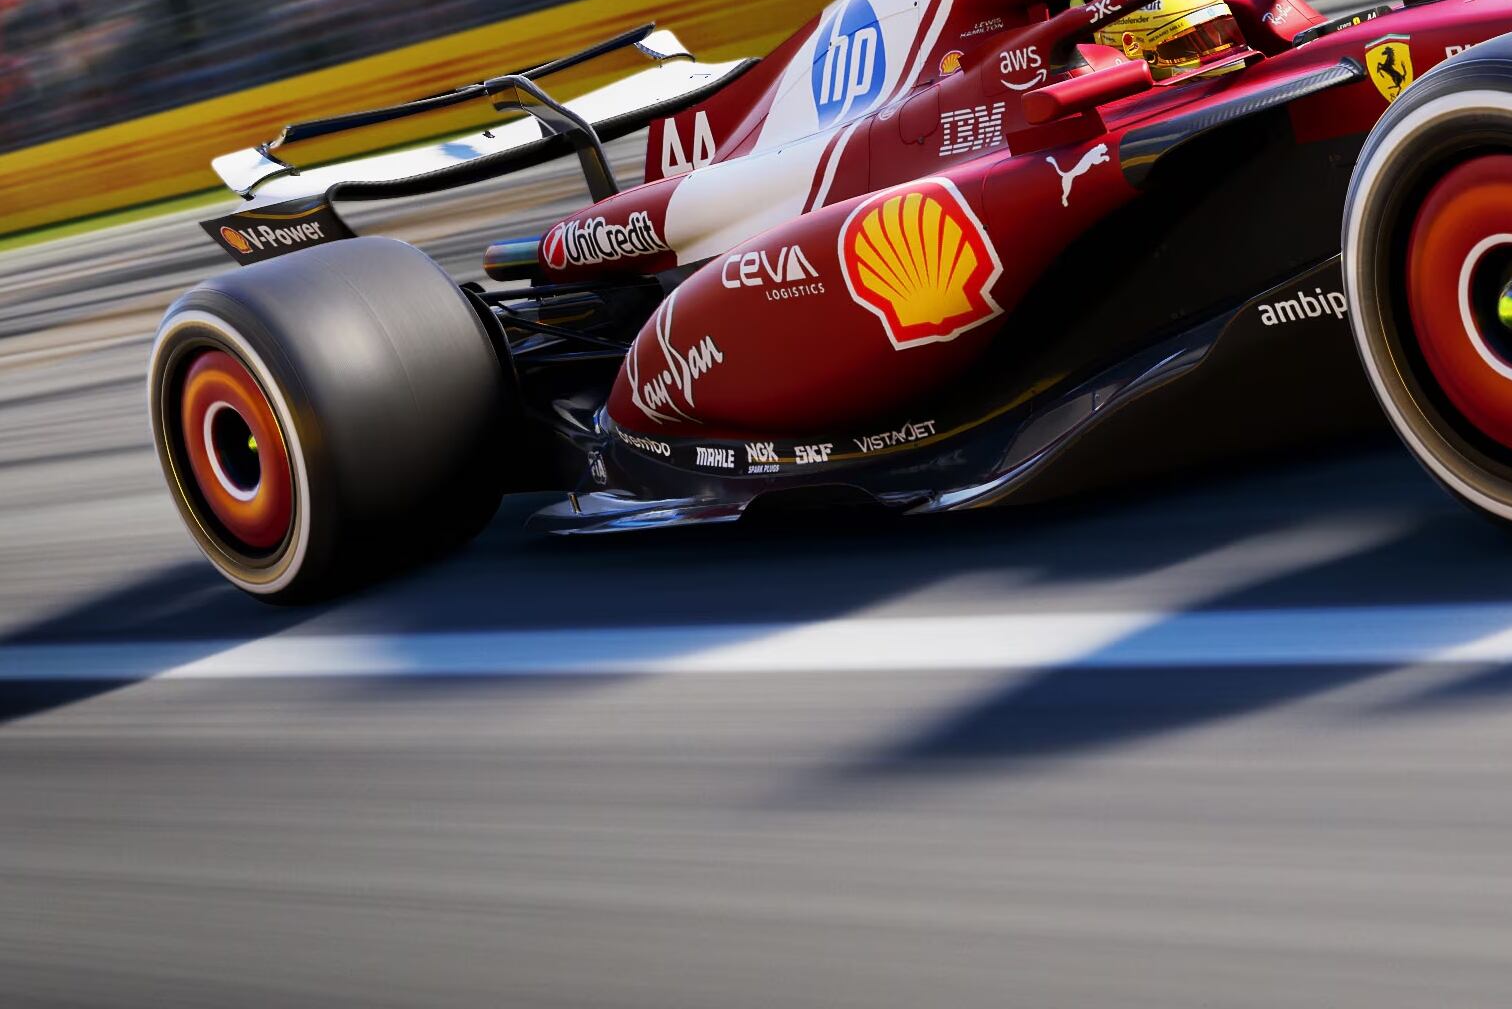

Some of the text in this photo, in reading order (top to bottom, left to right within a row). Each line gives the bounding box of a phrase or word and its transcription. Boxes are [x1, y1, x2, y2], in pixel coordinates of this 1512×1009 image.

[1000, 45, 1042, 74] aws
[661, 110, 716, 178] 44
[939, 102, 1005, 157] IBM
[238, 220, 325, 250] V-Power
[565, 215, 667, 262] UniCredit
[721, 245, 820, 289] CEVA
[765, 283, 826, 301] LOGISTICS
[696, 447, 735, 469] MAHLE
[745, 442, 779, 463] NGK
[794, 443, 833, 464] SKF
